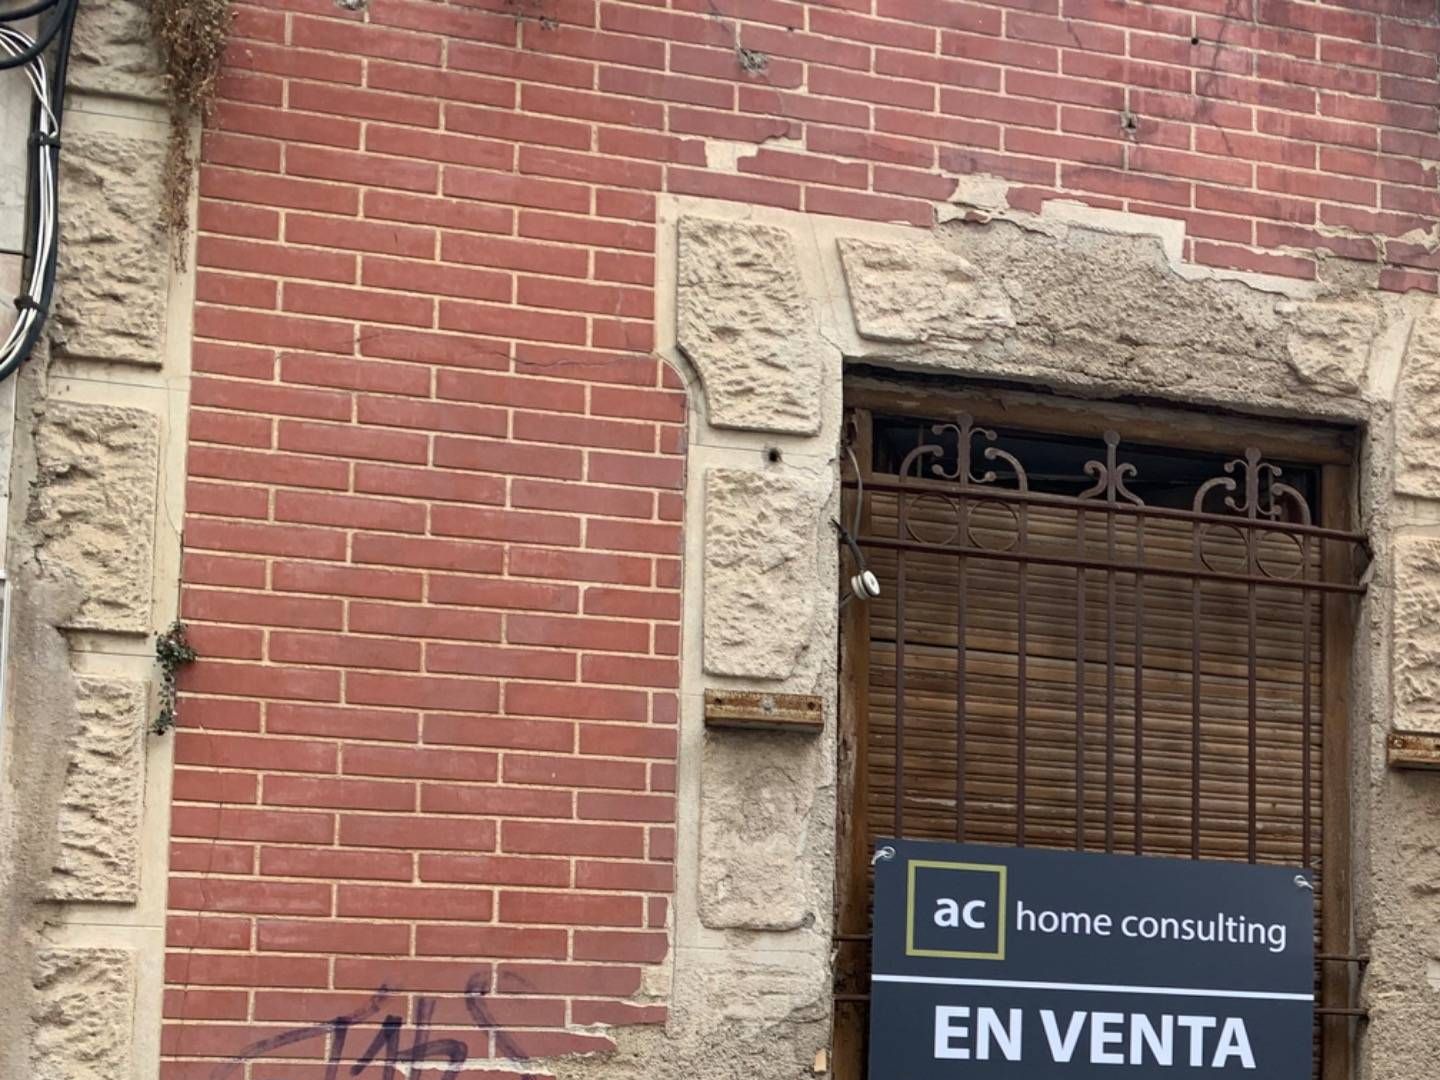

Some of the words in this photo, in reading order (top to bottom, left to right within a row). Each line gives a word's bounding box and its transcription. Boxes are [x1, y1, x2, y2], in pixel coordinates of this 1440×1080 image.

[933, 897, 986, 930] ac
[1016, 901, 1113, 937] home
[1121, 912, 1287, 953] consulting
[933, 1005, 1022, 1061] EN
[1039, 1009, 1257, 1069] VENTA
